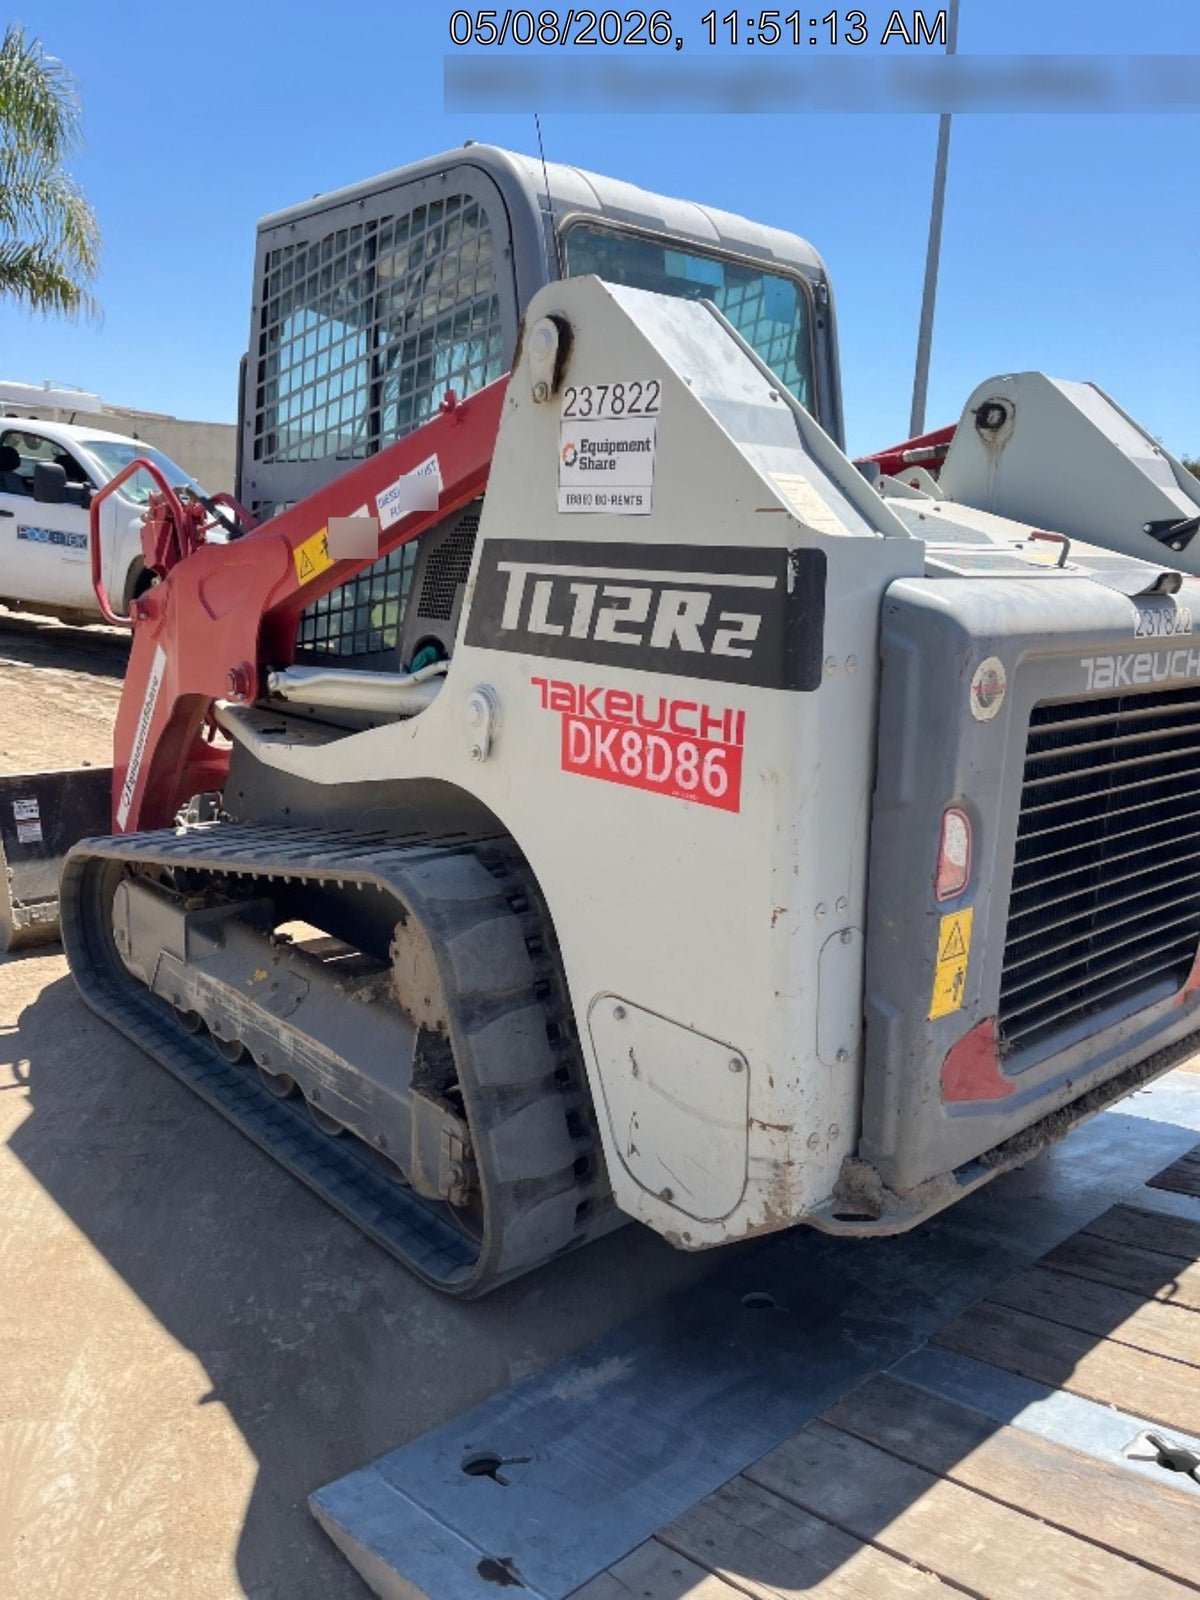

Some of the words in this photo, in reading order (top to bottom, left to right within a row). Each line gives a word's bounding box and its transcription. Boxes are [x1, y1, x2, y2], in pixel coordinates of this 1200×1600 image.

[563, 380, 660, 417] 237822
[580, 437, 651, 456] Equipment
[579, 457, 616, 470] Share
[497, 561, 778, 659] TL12R2
[1134, 608, 1192, 637] 237822
[568, 719, 729, 798] DK8D86
